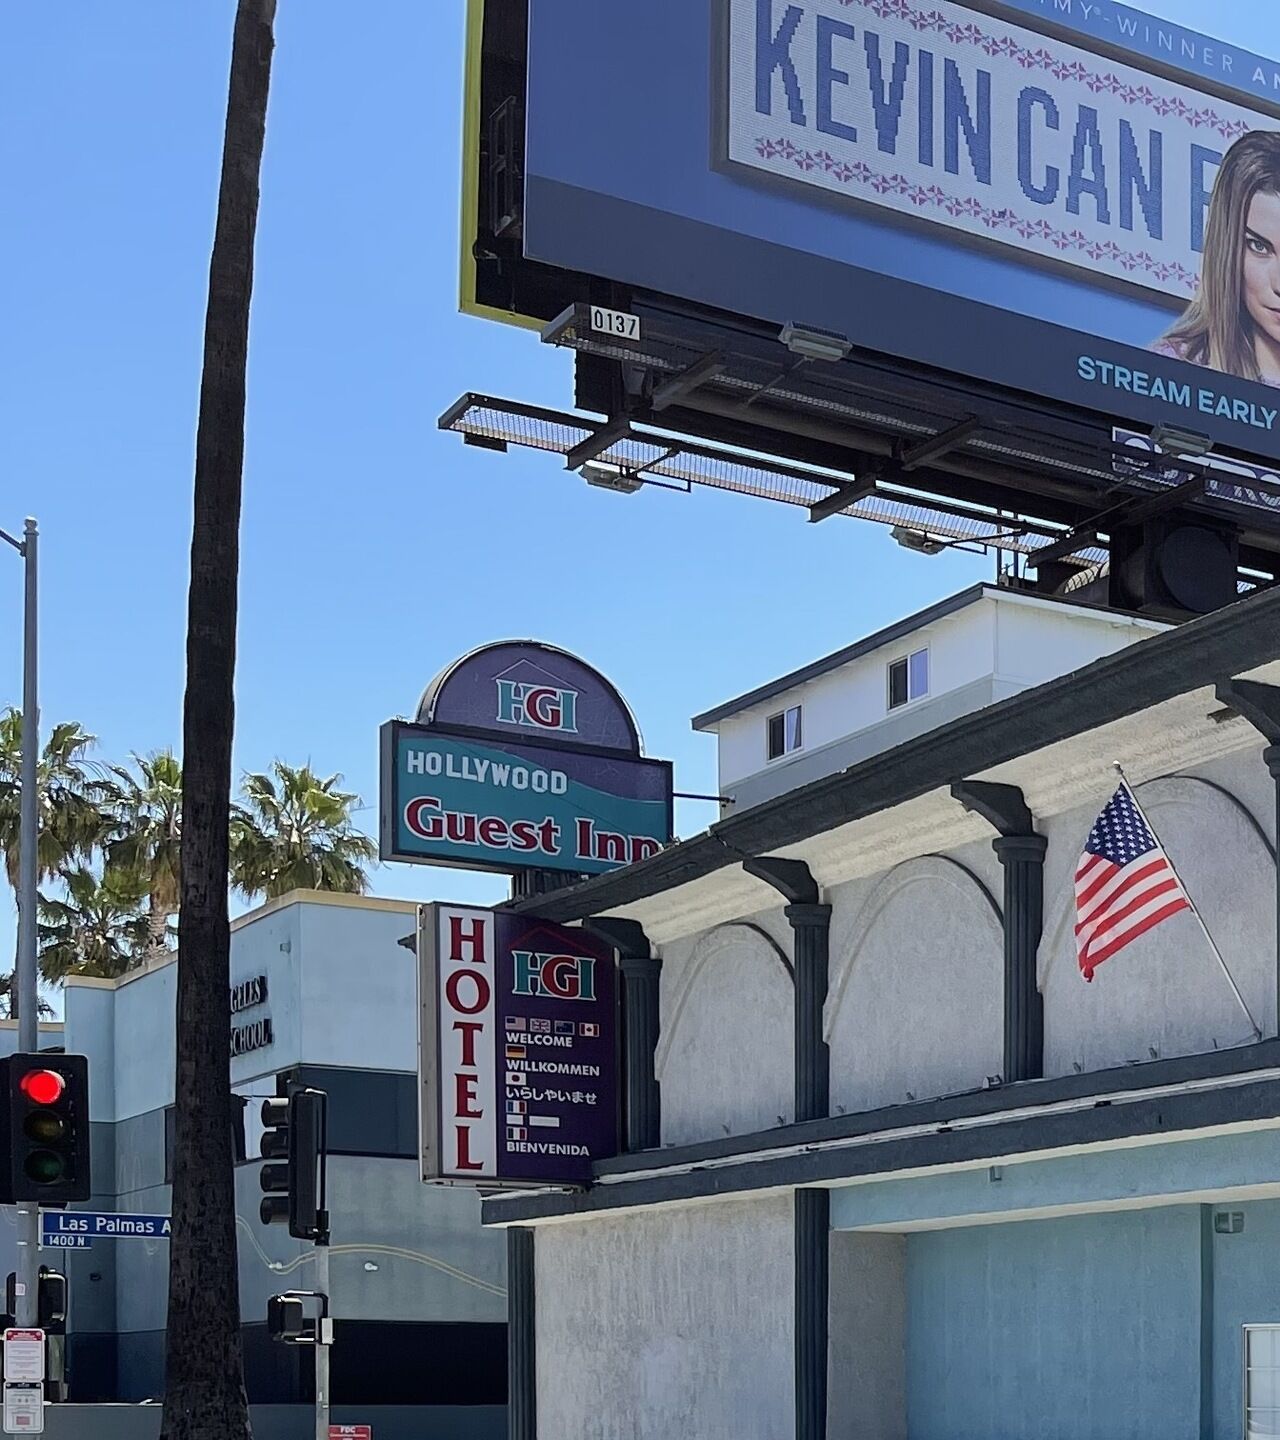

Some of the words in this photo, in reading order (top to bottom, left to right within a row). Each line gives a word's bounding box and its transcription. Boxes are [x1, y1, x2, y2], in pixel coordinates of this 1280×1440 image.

[755, 0, 992, 186] KEVIN
[1016, 86, 1163, 241] CAN
[594, 309, 638, 336] 0137
[1077, 356, 1191, 408] STREAM
[1198, 389, 1277, 430] EARLY
[496, 679, 579, 734] HGI
[407, 750, 568, 795] HOLLYWOOD
[404, 796, 562, 855] Guest
[574, 817, 664, 865] Inn
[512, 950, 597, 1001] HGI
[445, 916, 490, 1171] HOTEL
[506, 1032, 573, 1048] WELCOME
[506, 1059, 600, 1077] WILLKOMMEN
[506, 1141, 590, 1157] BIENVENIDA
[49, 1235, 75, 1246] 1400
[78, 1236, 85, 1246] N
[59, 1215, 89, 1231] Las
[95, 1216, 155, 1233] Palmas
